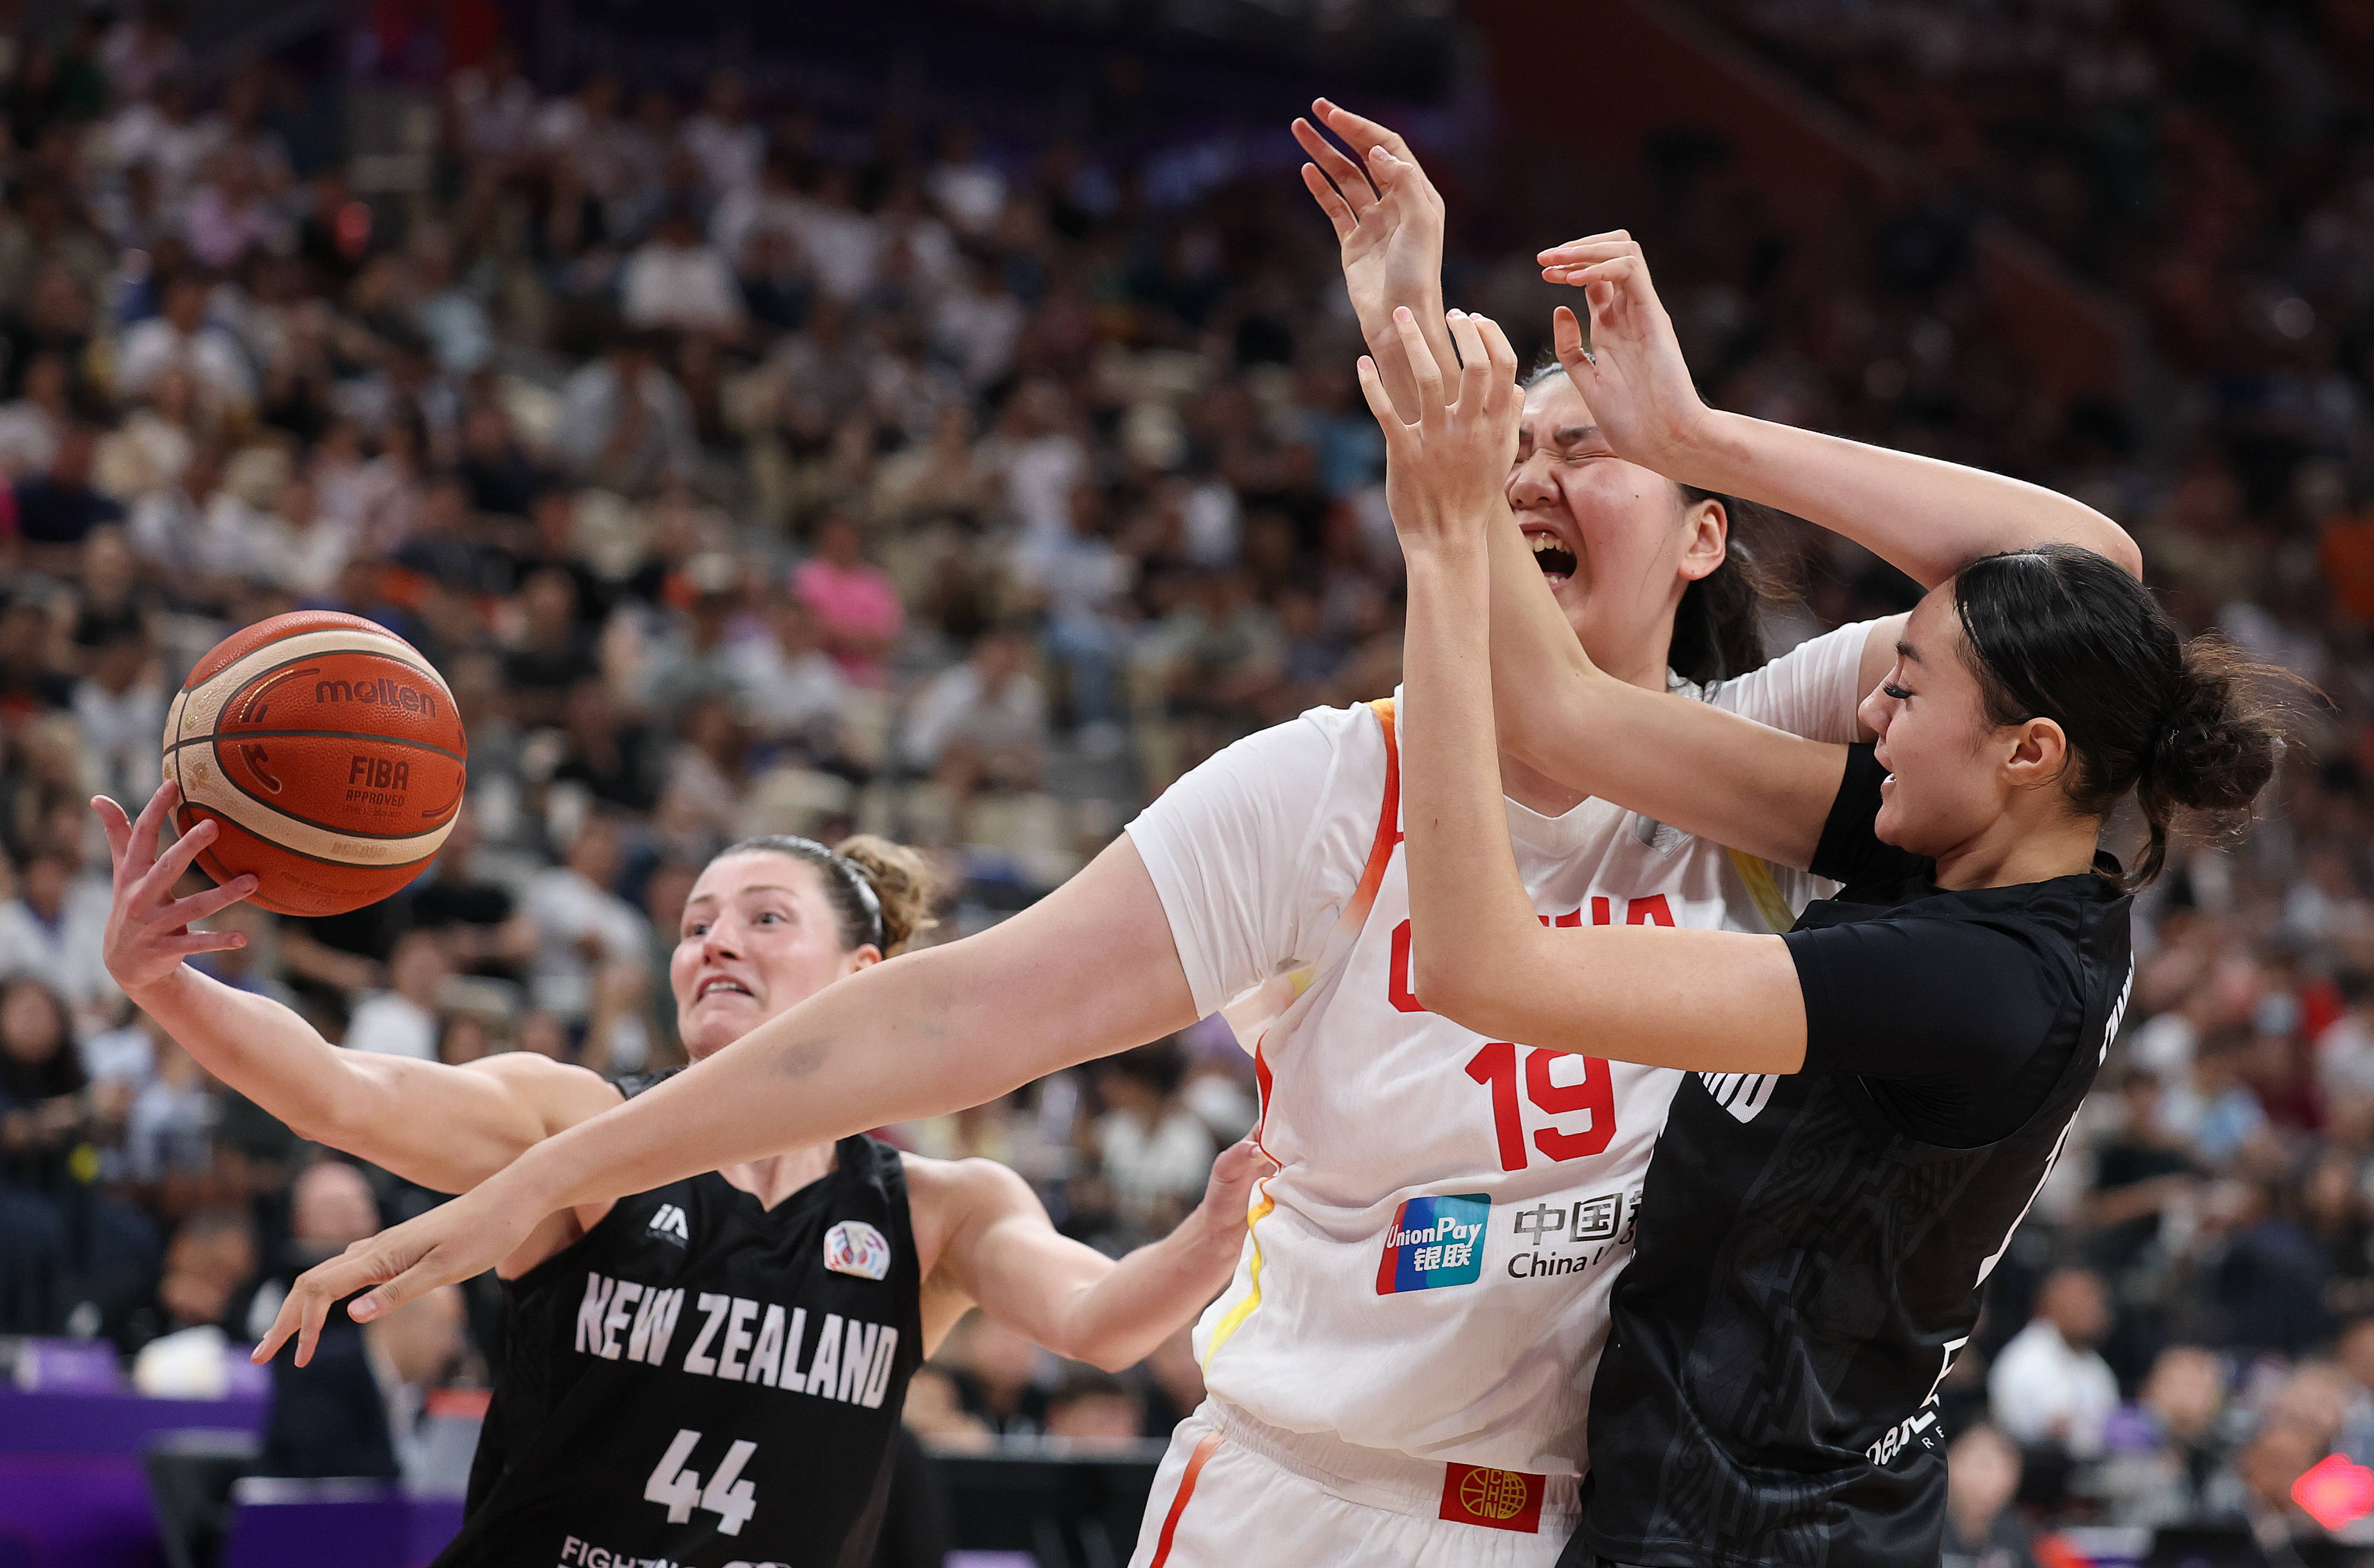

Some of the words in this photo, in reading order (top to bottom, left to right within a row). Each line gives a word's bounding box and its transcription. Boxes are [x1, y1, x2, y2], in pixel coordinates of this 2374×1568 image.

[315, 678, 436, 718] molten
[349, 755, 409, 790] FIBA
[345, 789, 406, 807] APPROVED
[1464, 1042, 1617, 1172] 19
[1386, 1216, 1483, 1248] UnionPay
[1413, 1242, 1472, 1271] 银联
[1508, 1251, 1588, 1279] China
[574, 1271, 686, 1366] NEW
[683, 1291, 899, 1410] ZEALAND
[643, 1428, 758, 1536] 44
[1483, 1469, 1502, 1518] CHN
